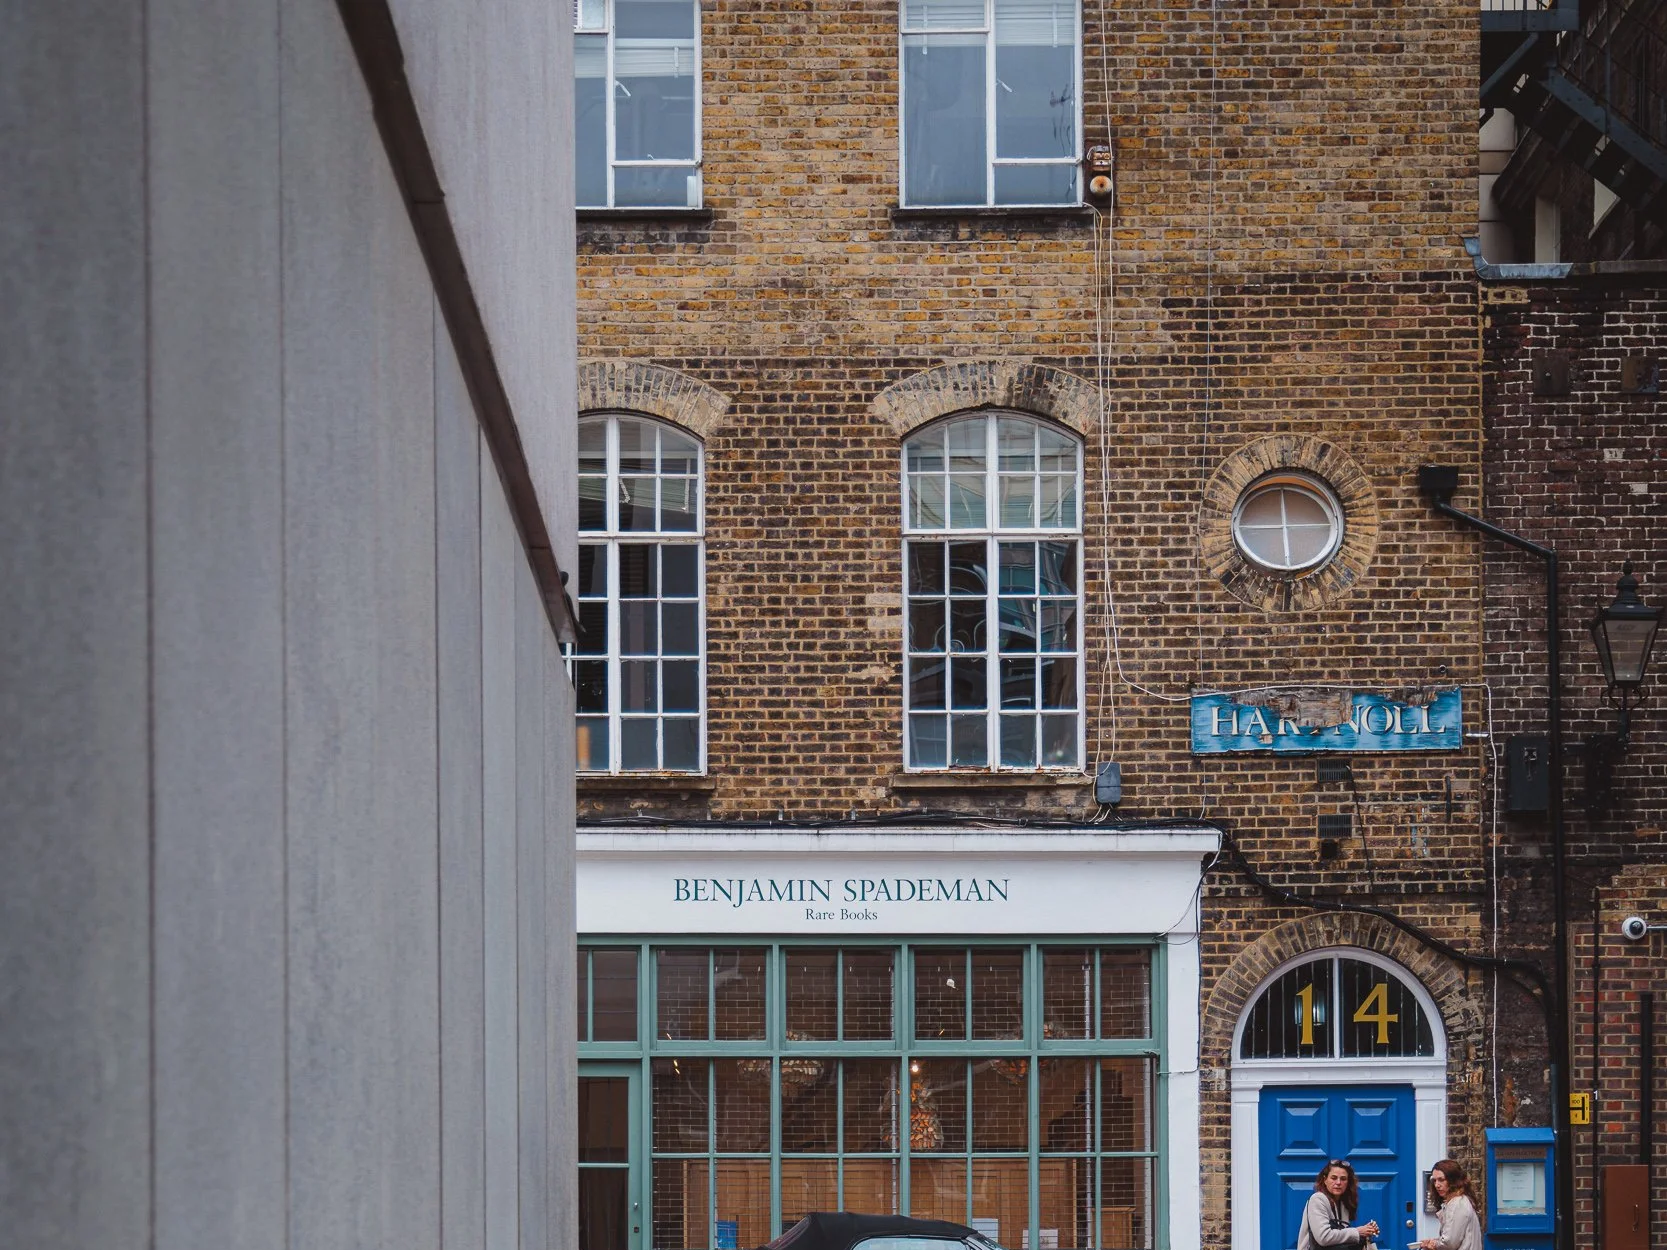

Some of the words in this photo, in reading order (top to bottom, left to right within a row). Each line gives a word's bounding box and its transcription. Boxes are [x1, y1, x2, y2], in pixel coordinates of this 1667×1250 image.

[1210, 704, 1446, 736] HARNOLL
[673, 878, 833, 908] BENJAMIN
[843, 878, 1011, 902] SPADEMAN
[805, 908, 835, 920] Rare
[840, 908, 878, 920] Books
